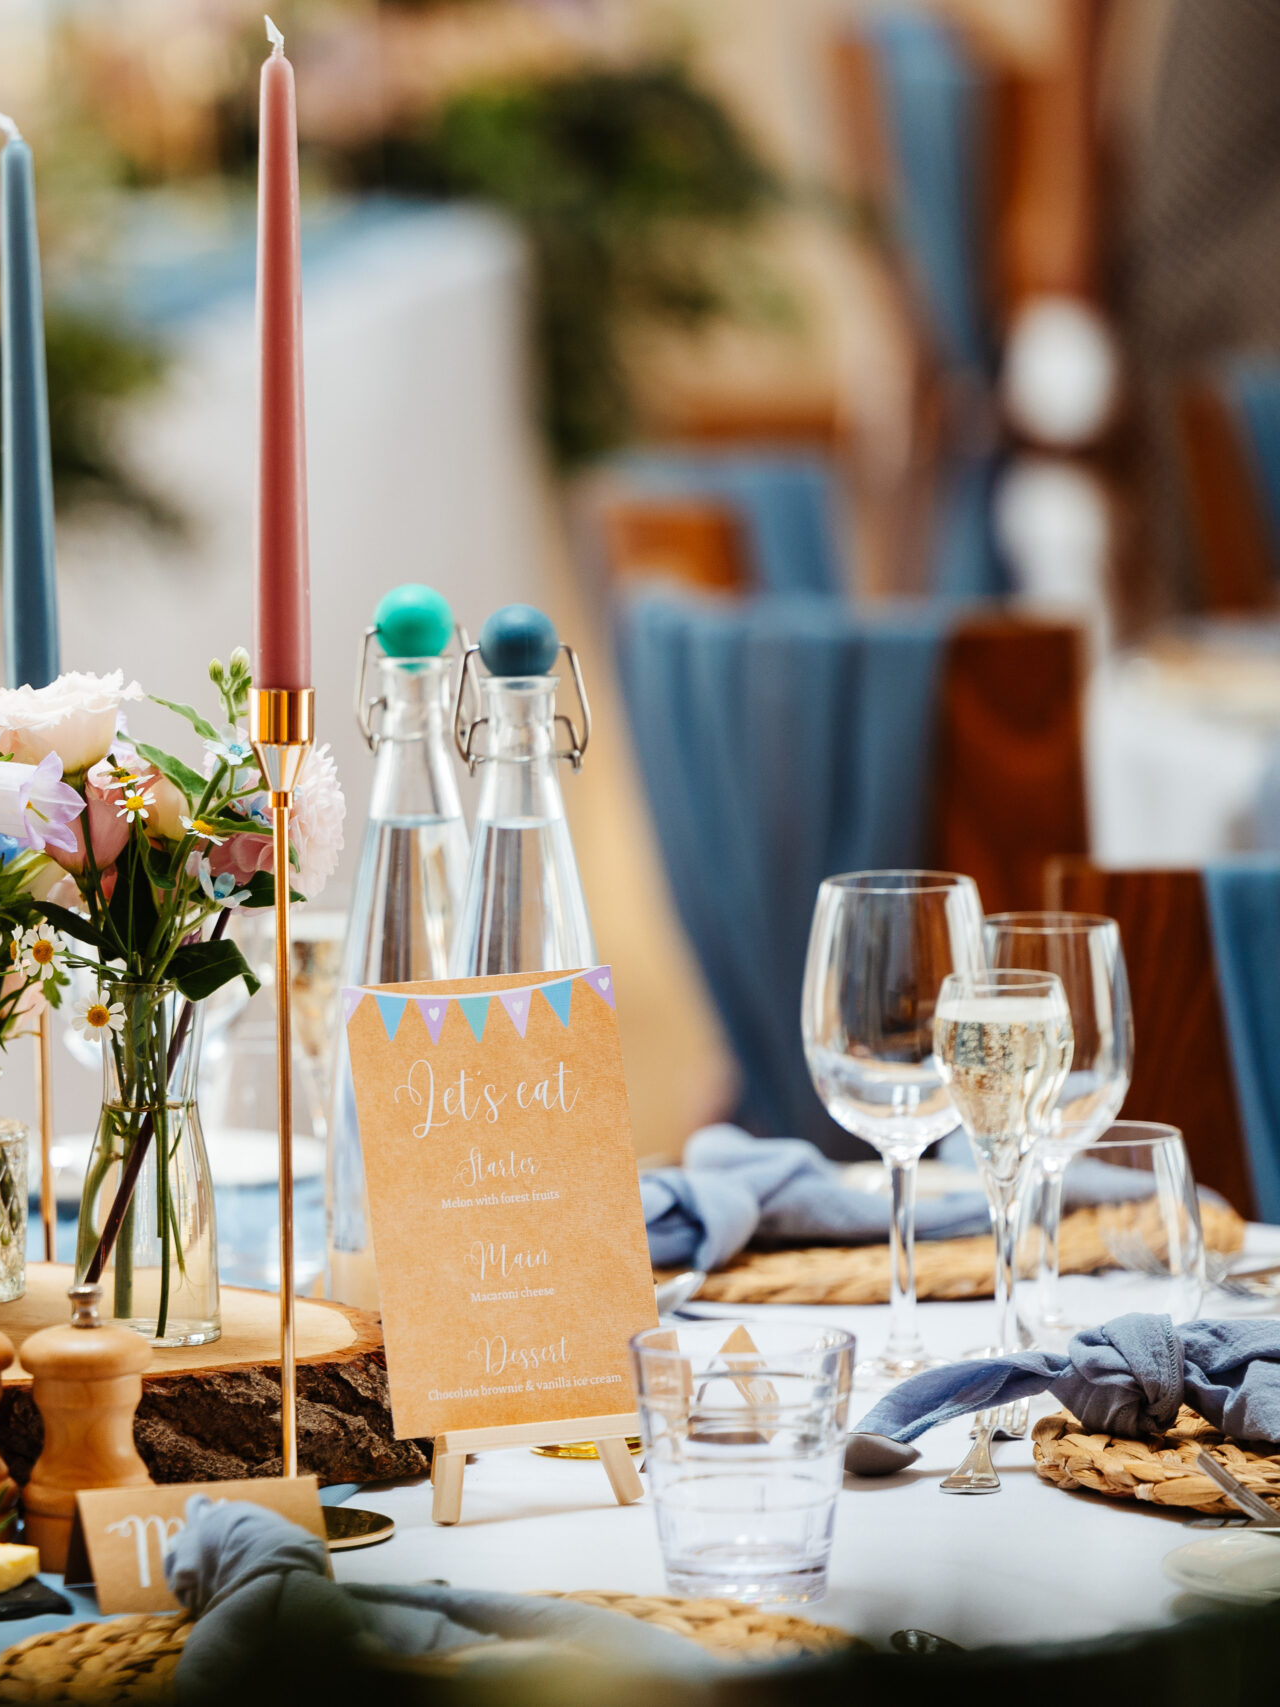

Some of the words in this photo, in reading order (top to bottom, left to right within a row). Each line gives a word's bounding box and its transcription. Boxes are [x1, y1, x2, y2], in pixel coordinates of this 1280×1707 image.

[393, 1059, 508, 1139] Let's
[516, 1061, 581, 1113] eat
[453, 1146, 541, 1187] Starter
[441, 1196, 474, 1210] Melon
[475, 1192, 499, 1207] with
[500, 1190, 531, 1205] forest
[531, 1189, 561, 1202] fruits
[463, 1240, 552, 1281] Main
[470, 1288, 519, 1303] Macaroni
[520, 1286, 555, 1298] cheese
[467, 1334, 571, 1376] Dessert
[427, 1385, 480, 1401] Chocolate
[480, 1381, 523, 1396] brownie
[525, 1379, 535, 1392] &
[536, 1375, 571, 1391] vanilla
[573, 1374, 588, 1387] ice
[589, 1373, 622, 1385] cream
